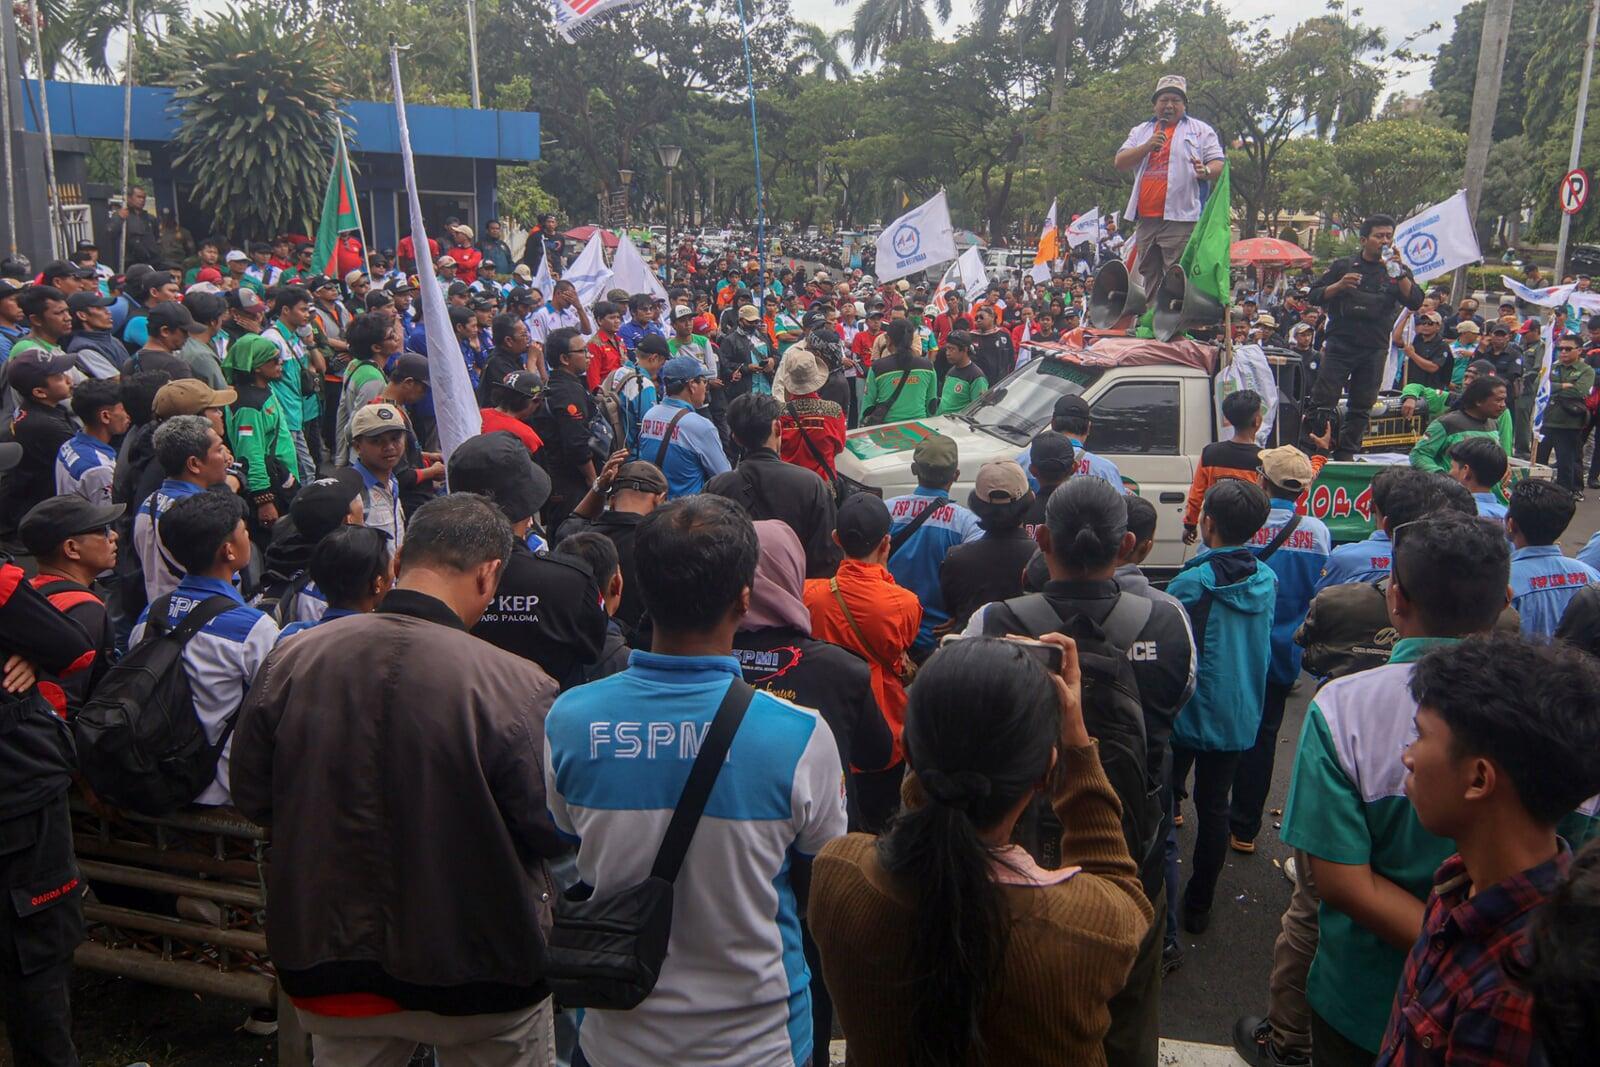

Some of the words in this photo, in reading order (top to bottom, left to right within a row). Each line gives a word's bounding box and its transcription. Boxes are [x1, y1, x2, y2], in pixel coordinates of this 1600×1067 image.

[892, 500, 911, 517] FSP
[1294, 529, 1313, 551] SPSI
[1371, 556, 1391, 569] FSP
[1530, 576, 1548, 589] FSP
[1549, 573, 1566, 587] LEM
[1567, 571, 1588, 586] SPSI
[499, 595, 540, 612] KEP
[501, 614, 539, 622] PALOMA
[589, 721, 730, 762] FSPM
